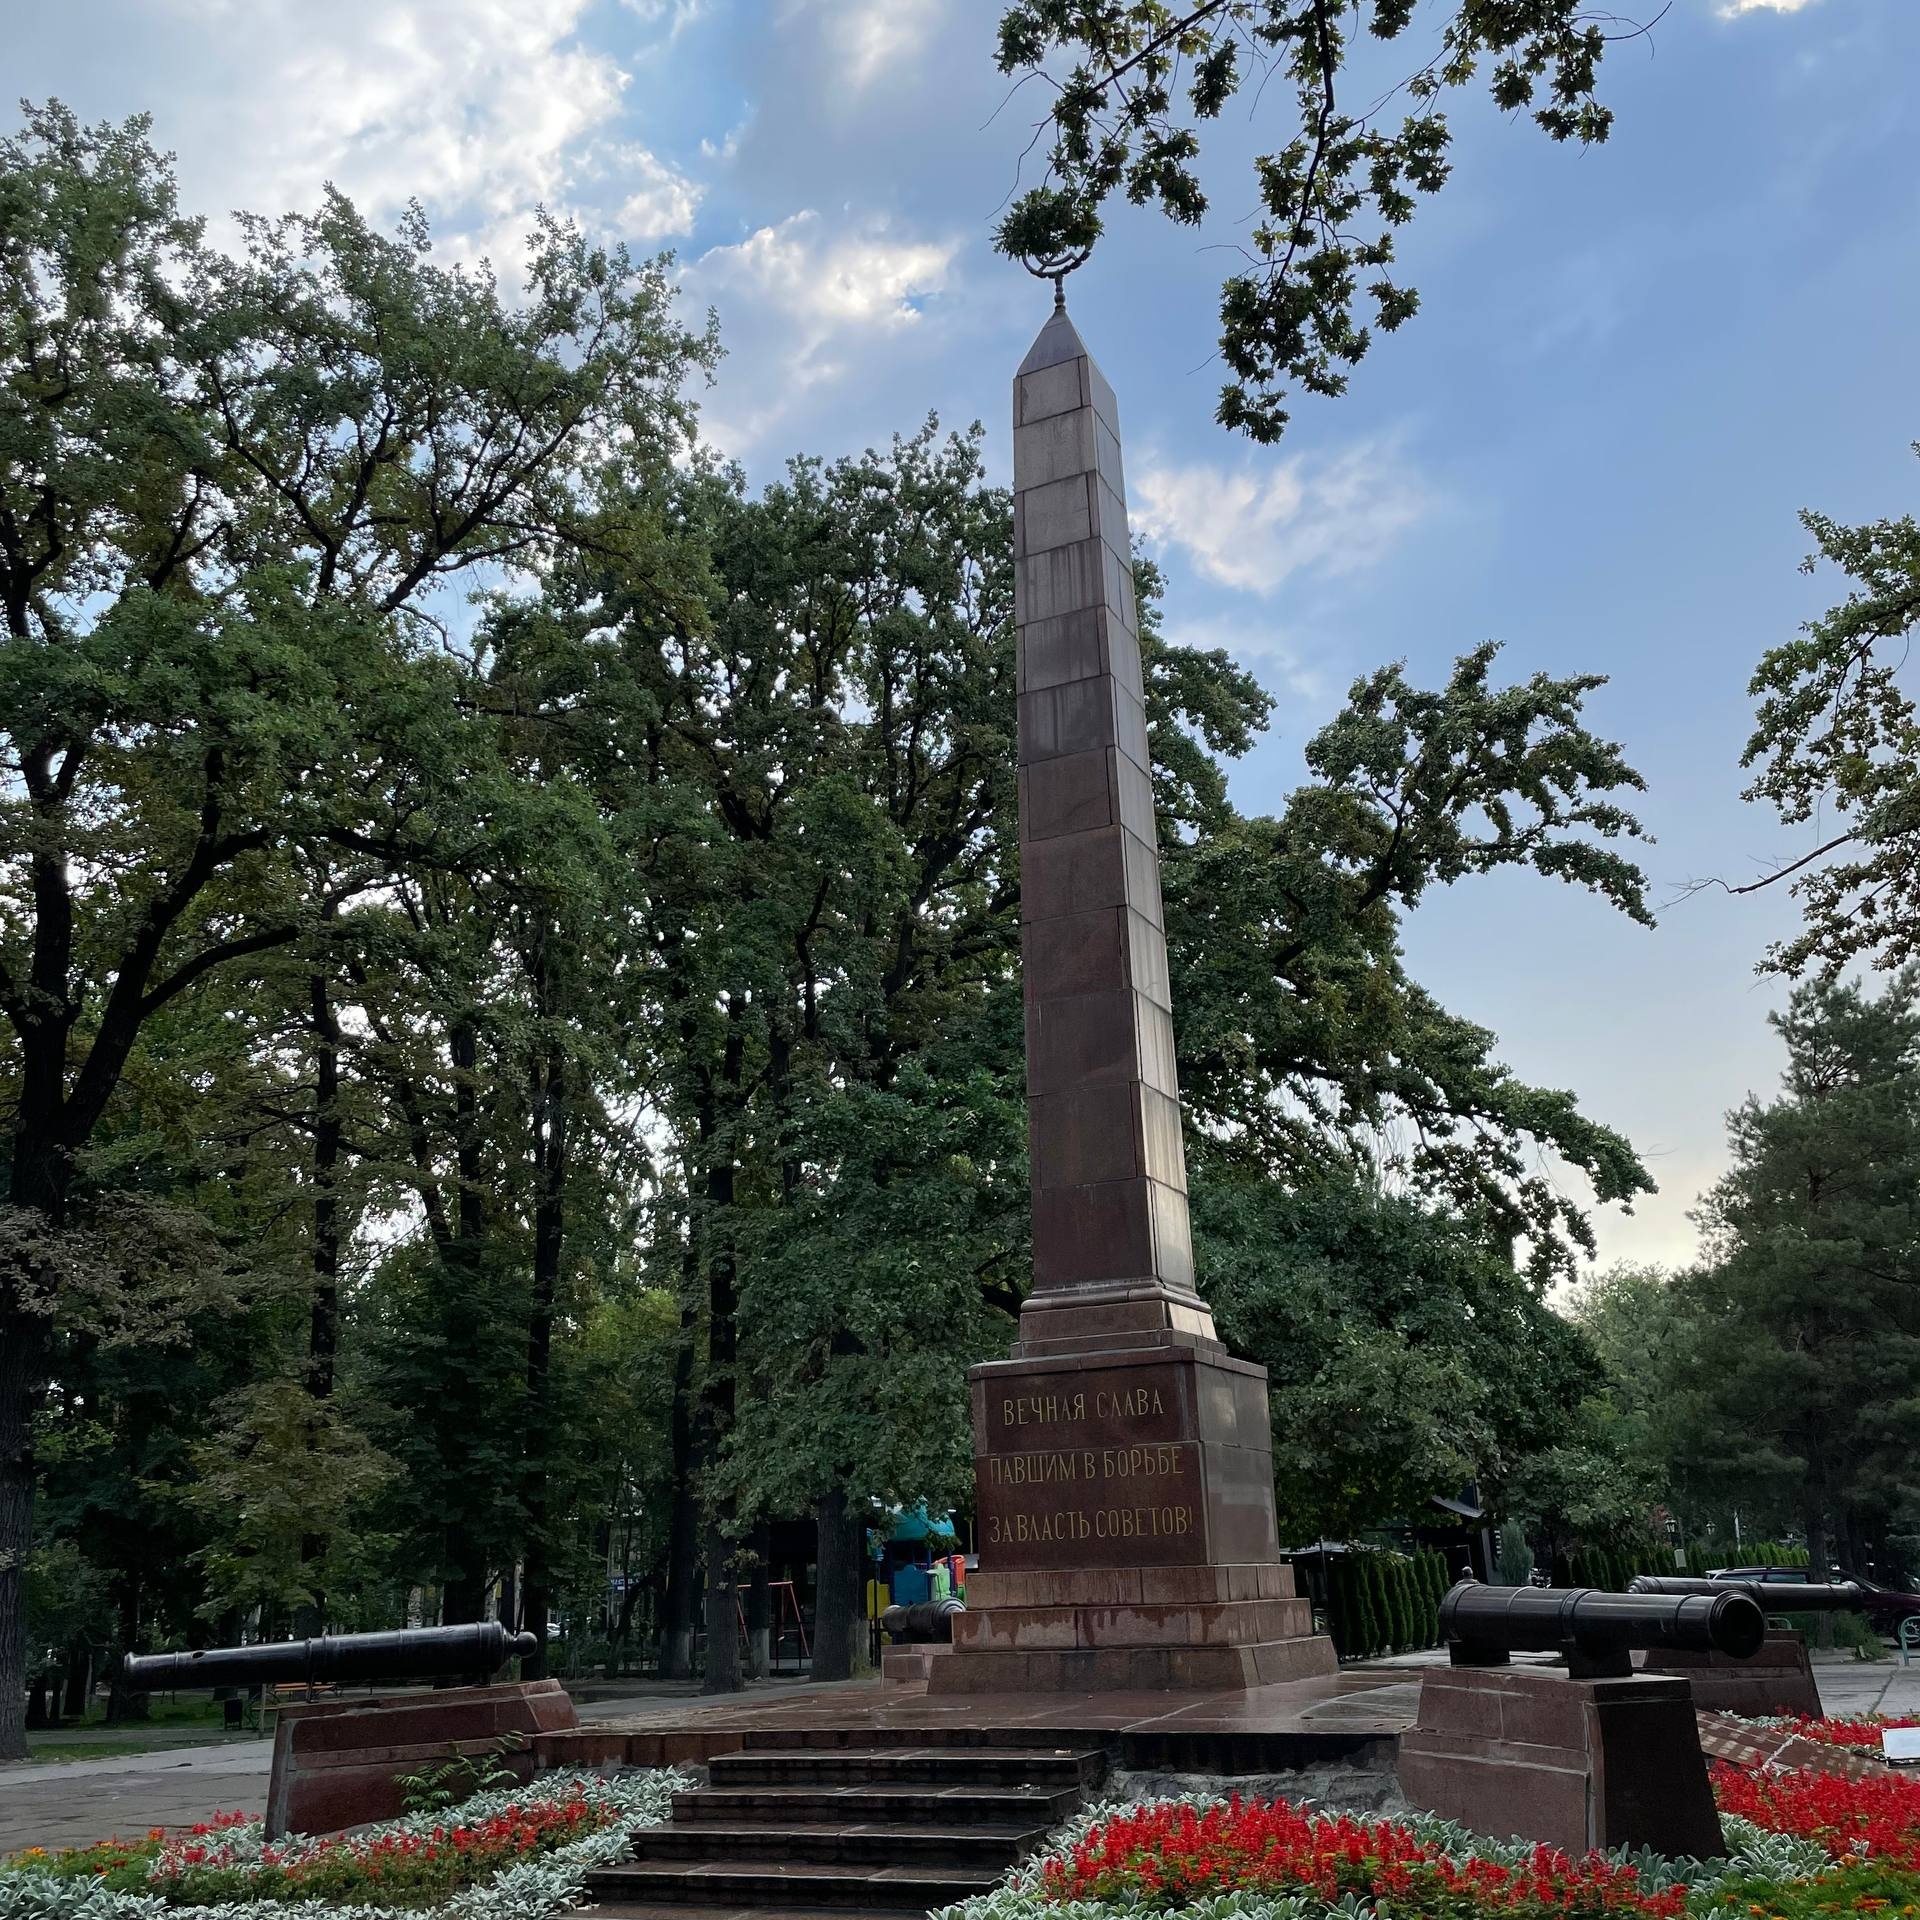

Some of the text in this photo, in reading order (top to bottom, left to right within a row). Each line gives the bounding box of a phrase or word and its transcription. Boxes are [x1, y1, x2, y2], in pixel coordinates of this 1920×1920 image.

[1003, 1388, 1165, 1426] ВЕЧНАЯ СЛАВА
[990, 1446, 1185, 1485] ПАВШИМ В БОРЬБЕ
[1095, 1506, 1194, 1538] СОВЕТОВ!
